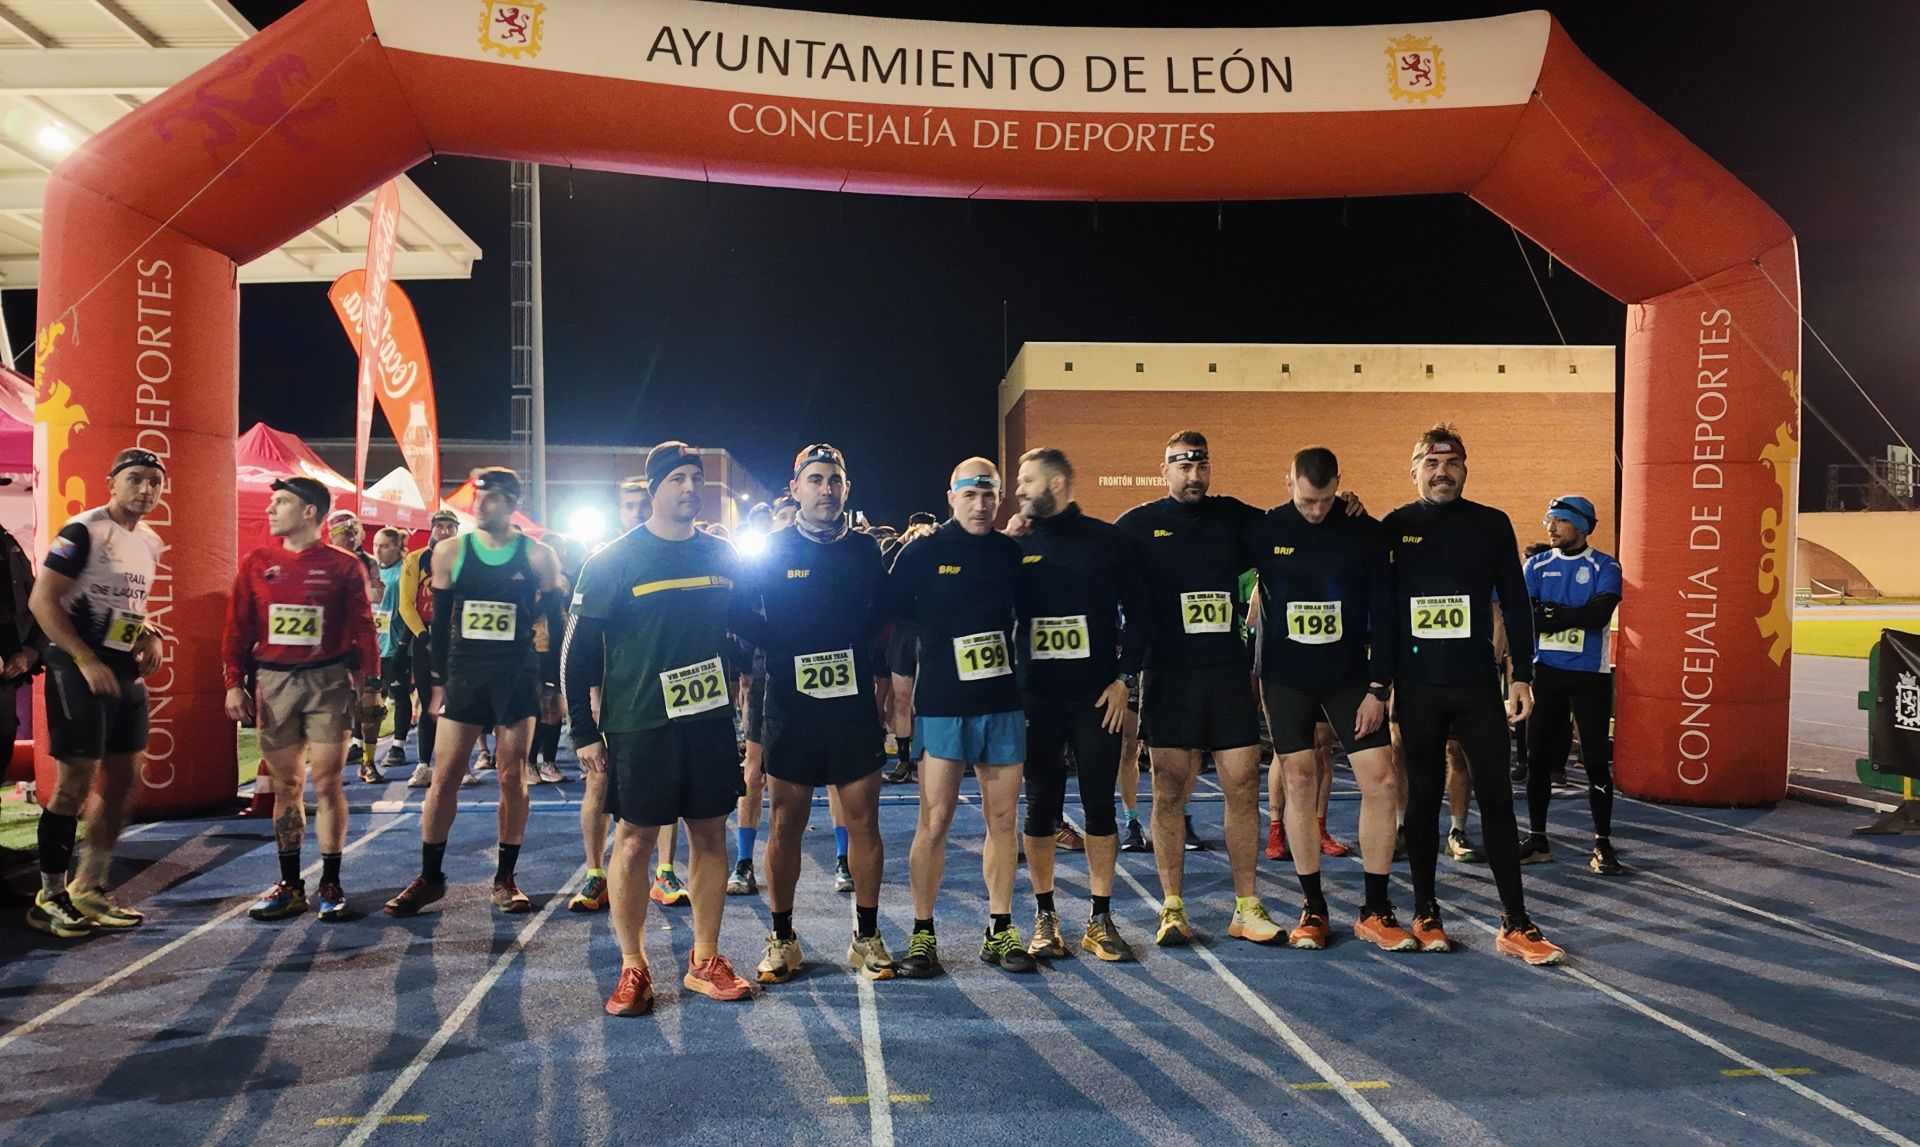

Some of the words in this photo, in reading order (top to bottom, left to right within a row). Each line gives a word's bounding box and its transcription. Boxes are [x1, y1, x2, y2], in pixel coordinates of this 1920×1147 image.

[646, 25, 1066, 93] AYUNTAMIENTO
[1085, 55, 1147, 93] DE
[1166, 48, 1294, 94] LEÓN
[728, 103, 957, 148] CONCEJALÍA
[973, 119, 1019, 150] DE
[1035, 121, 1216, 152] DEPORTES
[135, 258, 172, 458] DEPORTES
[1693, 308, 1731, 489] DEPORTES
[1098, 475, 1133, 486] FRONTÓN
[1689, 505, 1722, 550] DE
[1402, 535, 1423, 544] BRIF
[1273, 546, 1295, 555] BRIF
[787, 569, 811, 579] BRIF
[938, 565, 962, 574] BRIF
[469, 612, 508, 631] 226
[1188, 603, 1227, 624] 201
[1417, 608, 1464, 629] 240
[274, 617, 317, 636] 224
[1294, 614, 1337, 635] 198
[1036, 629, 1081, 651] 200
[964, 644, 1006, 671] 199
[802, 664, 850, 690] 203
[1678, 566, 1720, 785] CONCEJALÍA
[670, 674, 722, 708] 202
